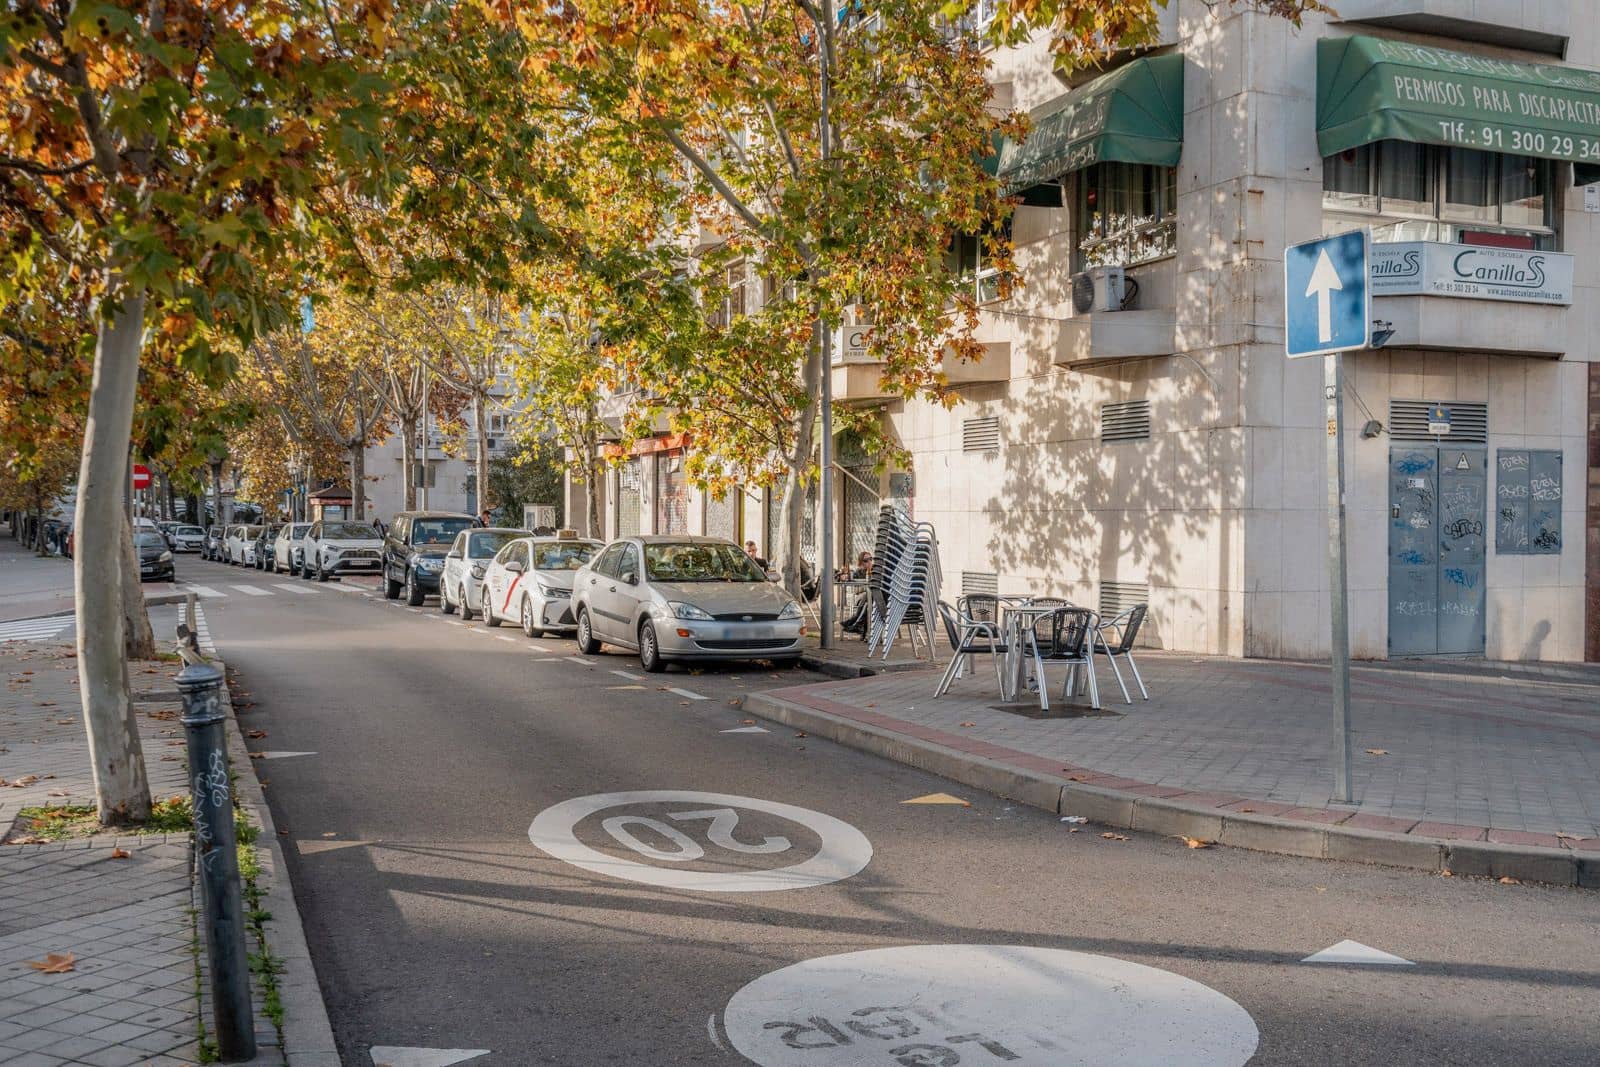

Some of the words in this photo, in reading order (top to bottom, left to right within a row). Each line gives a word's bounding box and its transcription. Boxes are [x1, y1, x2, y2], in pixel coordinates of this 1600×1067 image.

[1393, 74, 1466, 108] PERMISOS
[1472, 85, 1513, 113] PARA
[1439, 121, 1475, 145] Tlf.:
[1482, 127, 1503, 149] 91
[1511, 130, 1545, 153] 300
[1551, 135, 1574, 156] 29
[1579, 139, 1600, 160] 34
[1371, 250, 1420, 277] nillaS
[1453, 250, 1545, 289] CanillaS
[602, 808, 792, 861] 20
